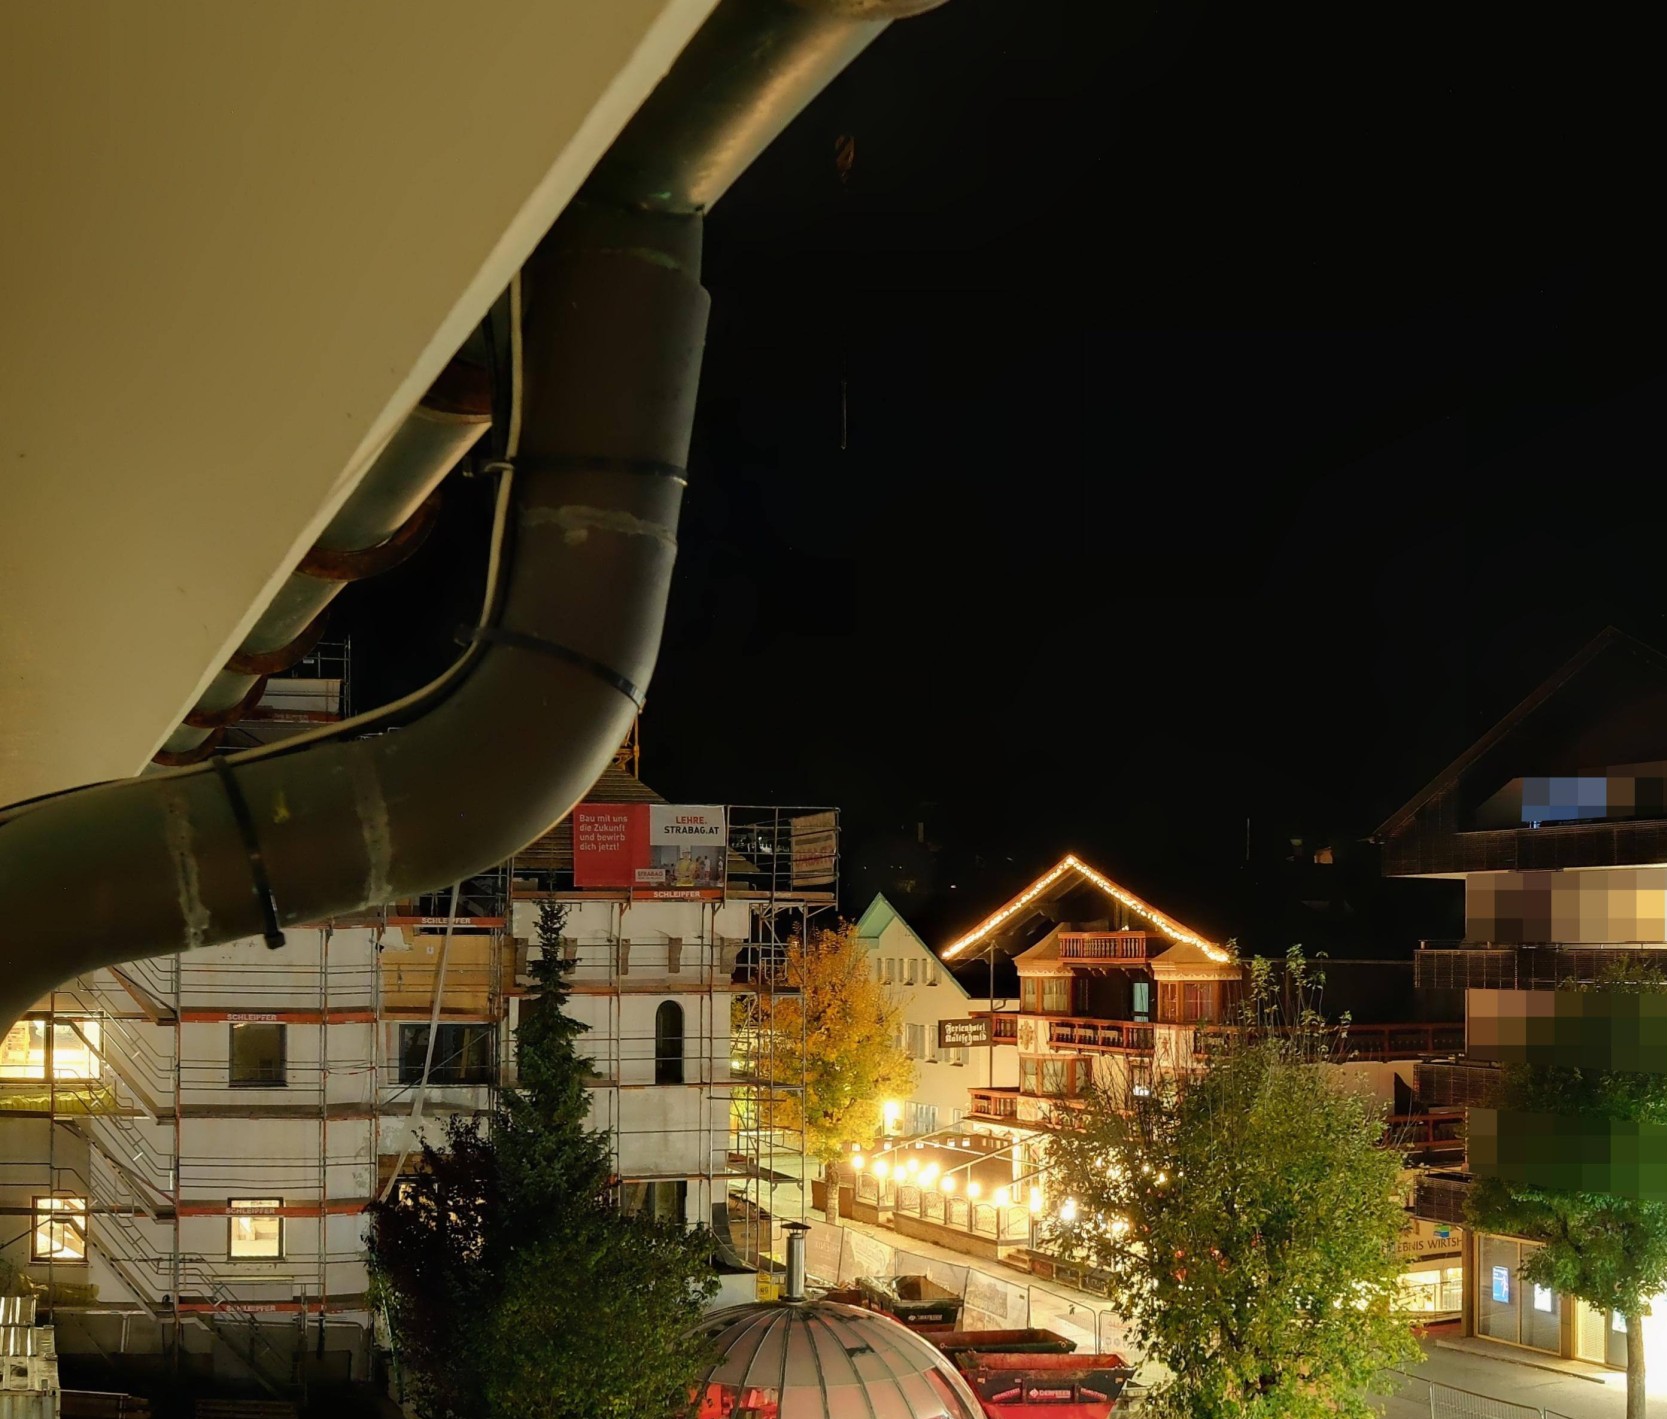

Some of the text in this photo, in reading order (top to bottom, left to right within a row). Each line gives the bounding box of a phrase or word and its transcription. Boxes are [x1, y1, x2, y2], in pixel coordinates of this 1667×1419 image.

[579, 814, 628, 823] Bau mit uns
[675, 816, 708, 825] LEHRE.
[579, 823, 625, 832] die Zukunft
[663, 825, 720, 835] STRABAG.AT
[579, 833, 625, 841] und bewirb
[579, 843, 620, 852] dich jetzt!
[653, 890, 701, 898] SCHLEIPFER
[421, 917, 471, 925] SCHLEPFER
[226, 1013, 277, 1021] SCHLEIPFER
[944, 1022, 986, 1035] Ferienhotel
